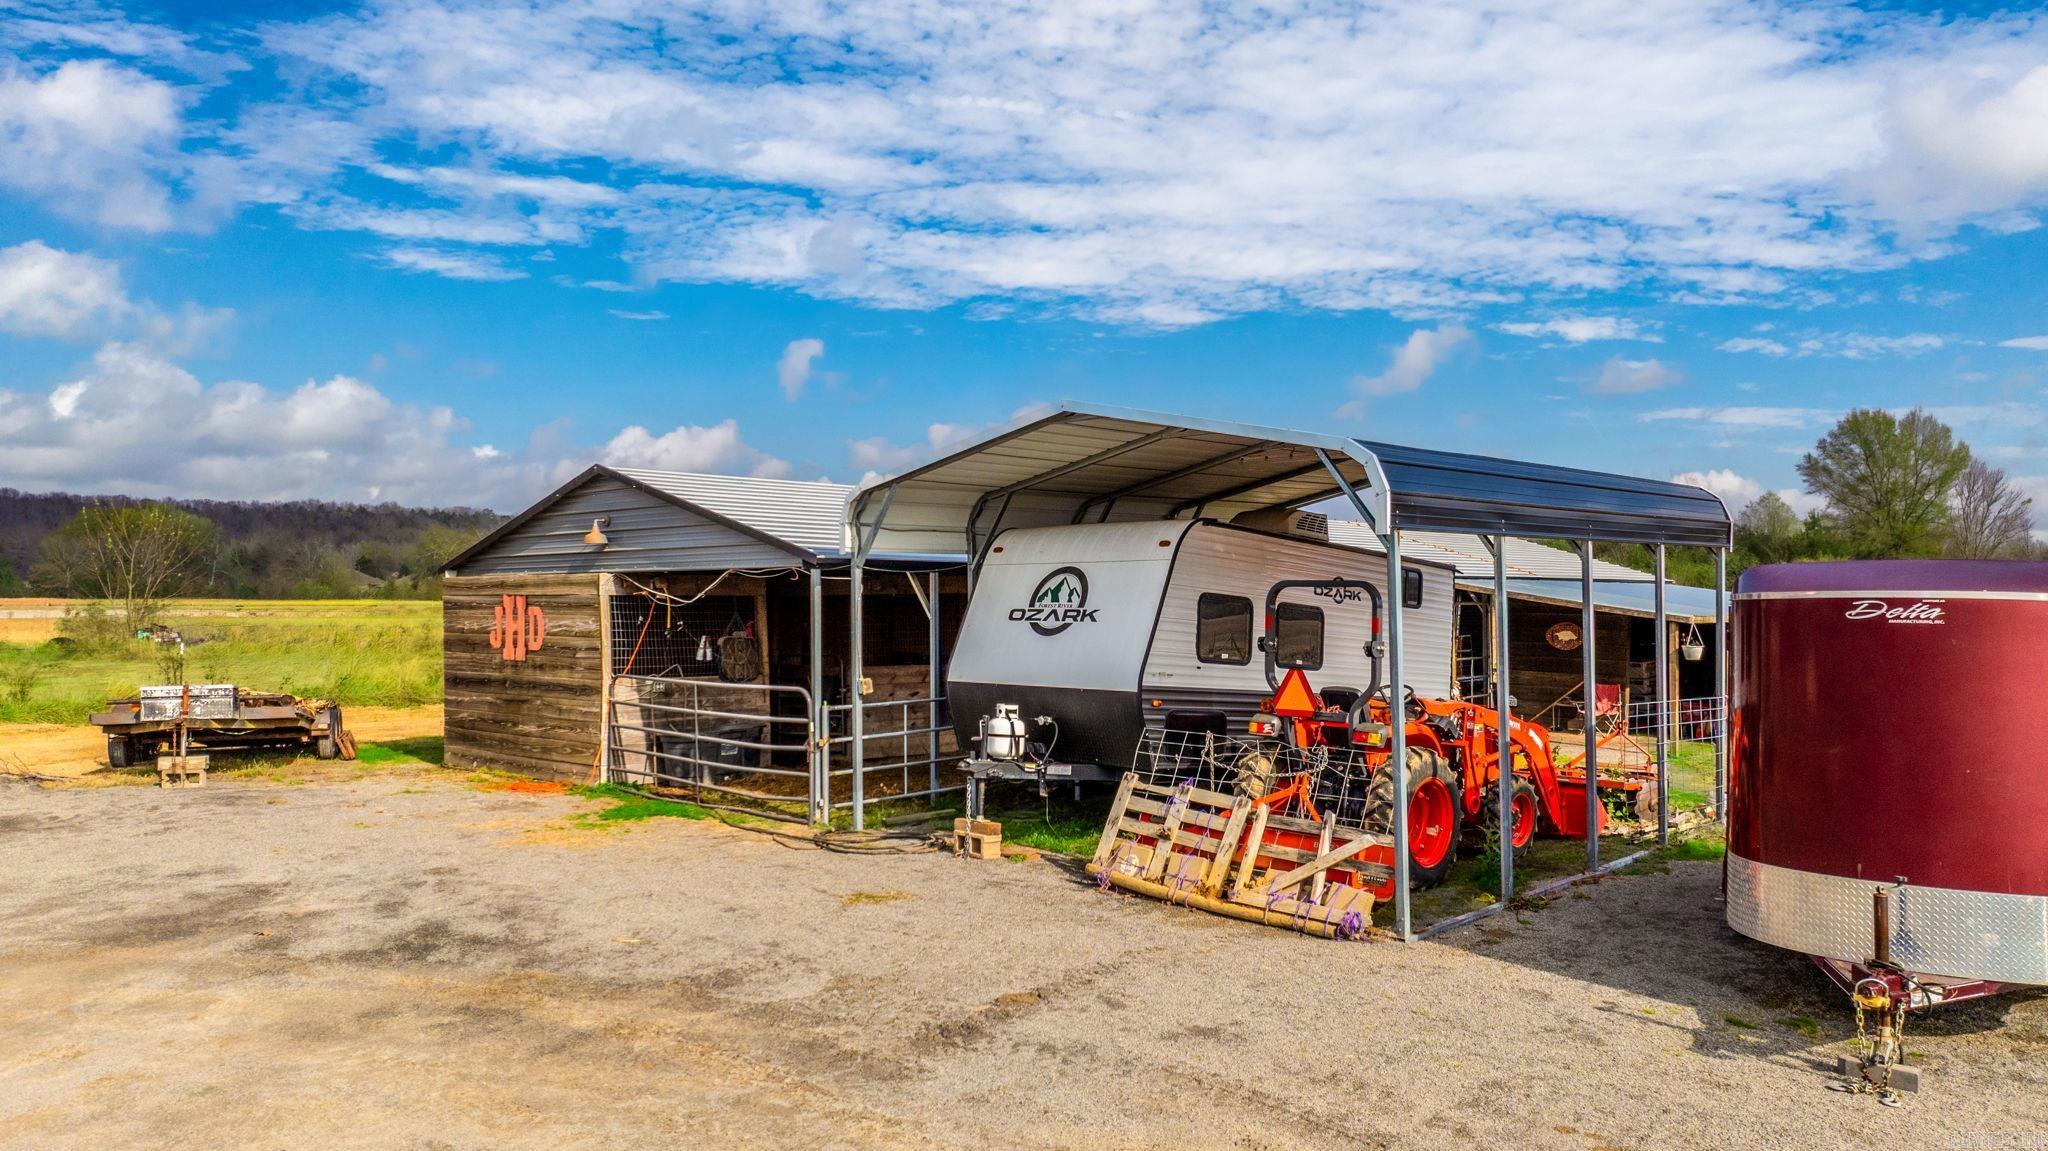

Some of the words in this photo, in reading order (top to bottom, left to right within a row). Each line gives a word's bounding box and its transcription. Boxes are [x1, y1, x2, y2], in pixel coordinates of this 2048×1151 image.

[1313, 586, 1362, 602] OZARK
[1008, 608, 1101, 623] OZARK
[1845, 600, 1945, 619] Delta
[489, 594, 545, 661] JHD
